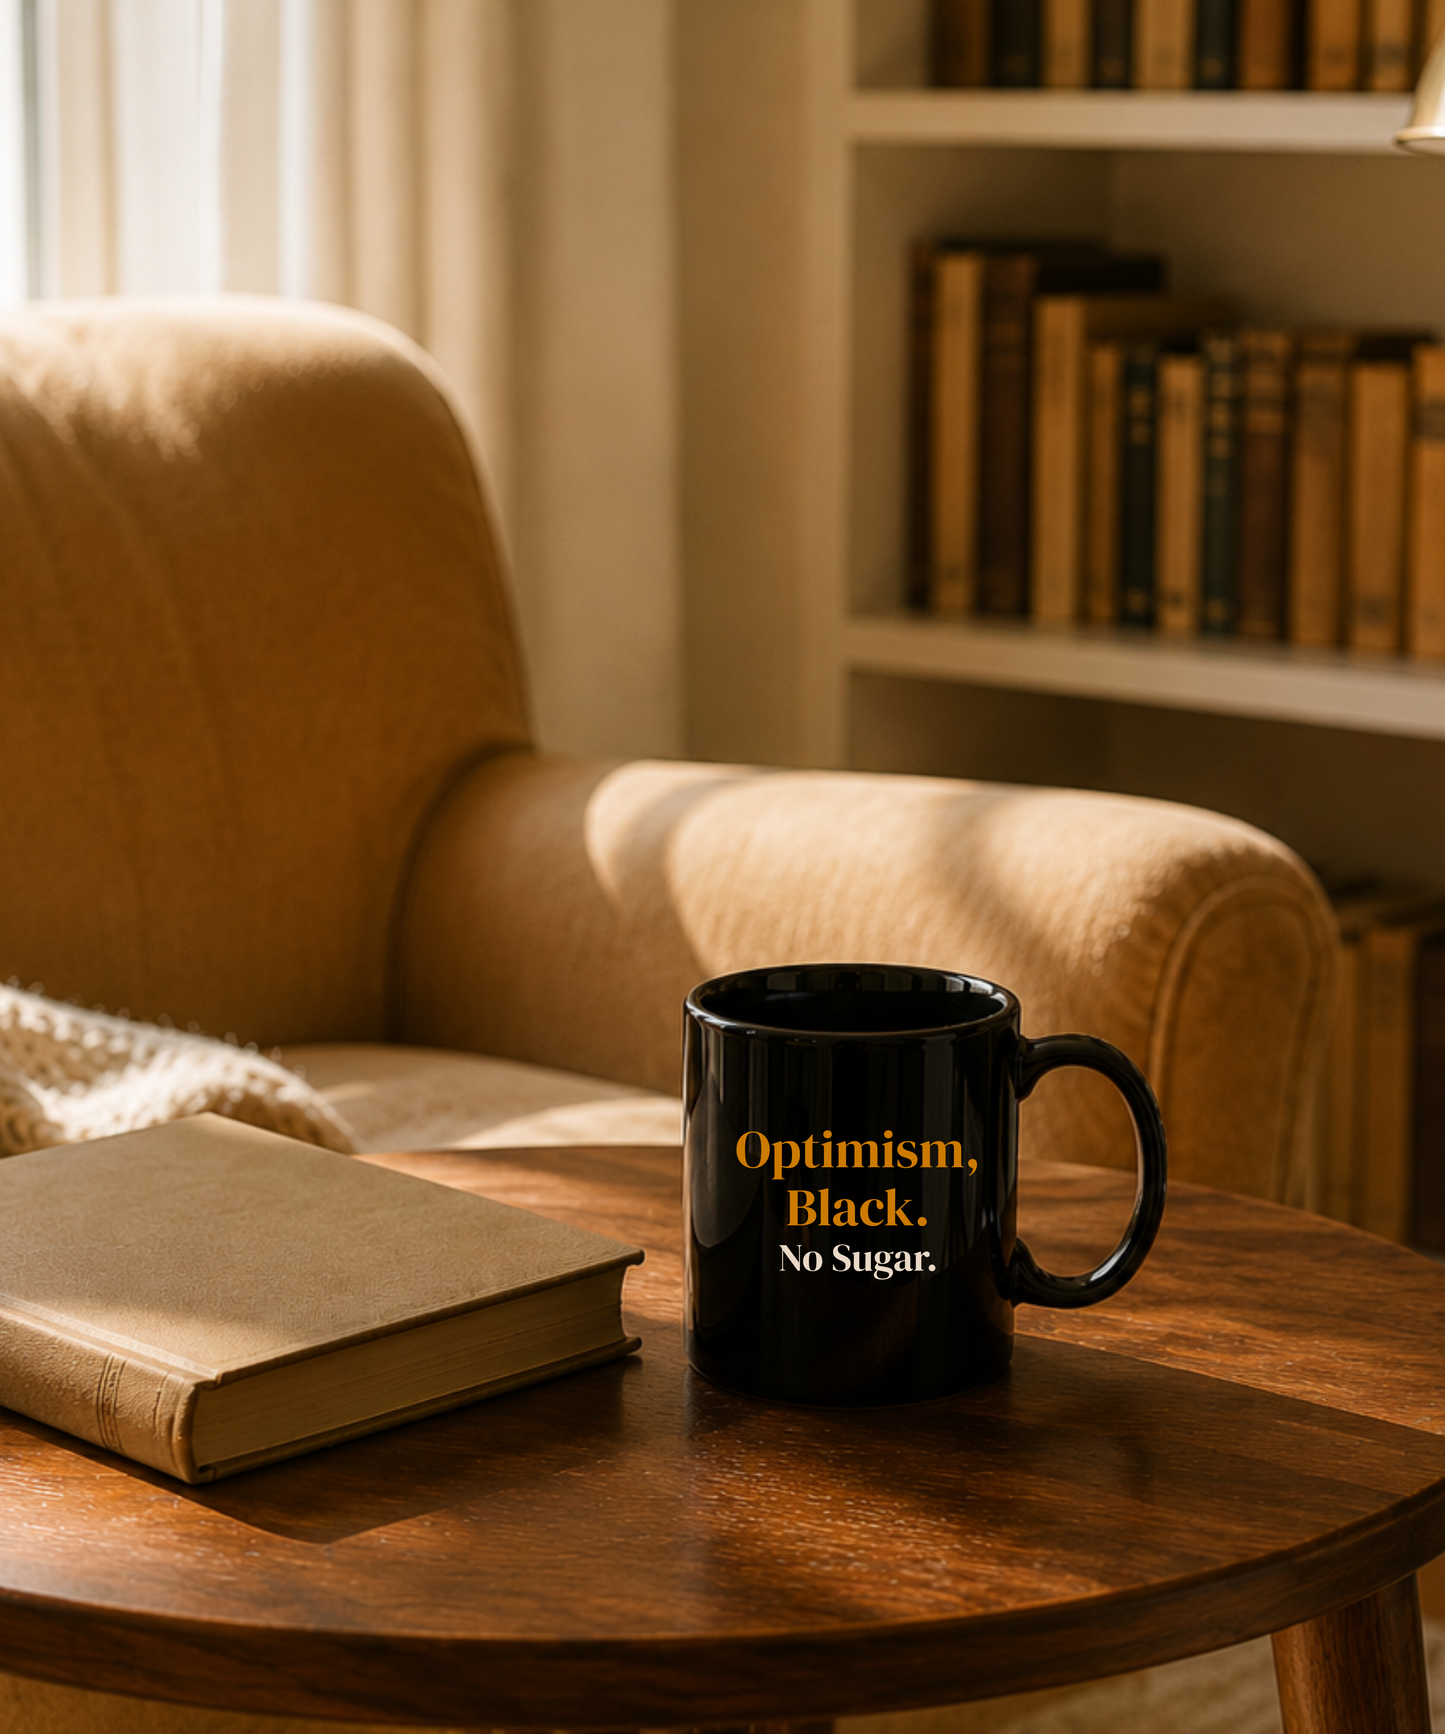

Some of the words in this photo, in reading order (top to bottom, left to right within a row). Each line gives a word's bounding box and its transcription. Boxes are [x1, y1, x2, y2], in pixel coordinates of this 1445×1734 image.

[735, 1129, 978, 1180] Optimism,
[787, 1188, 928, 1227] Black.
[779, 1244, 823, 1272] No
[832, 1243, 936, 1281] Sugar.
